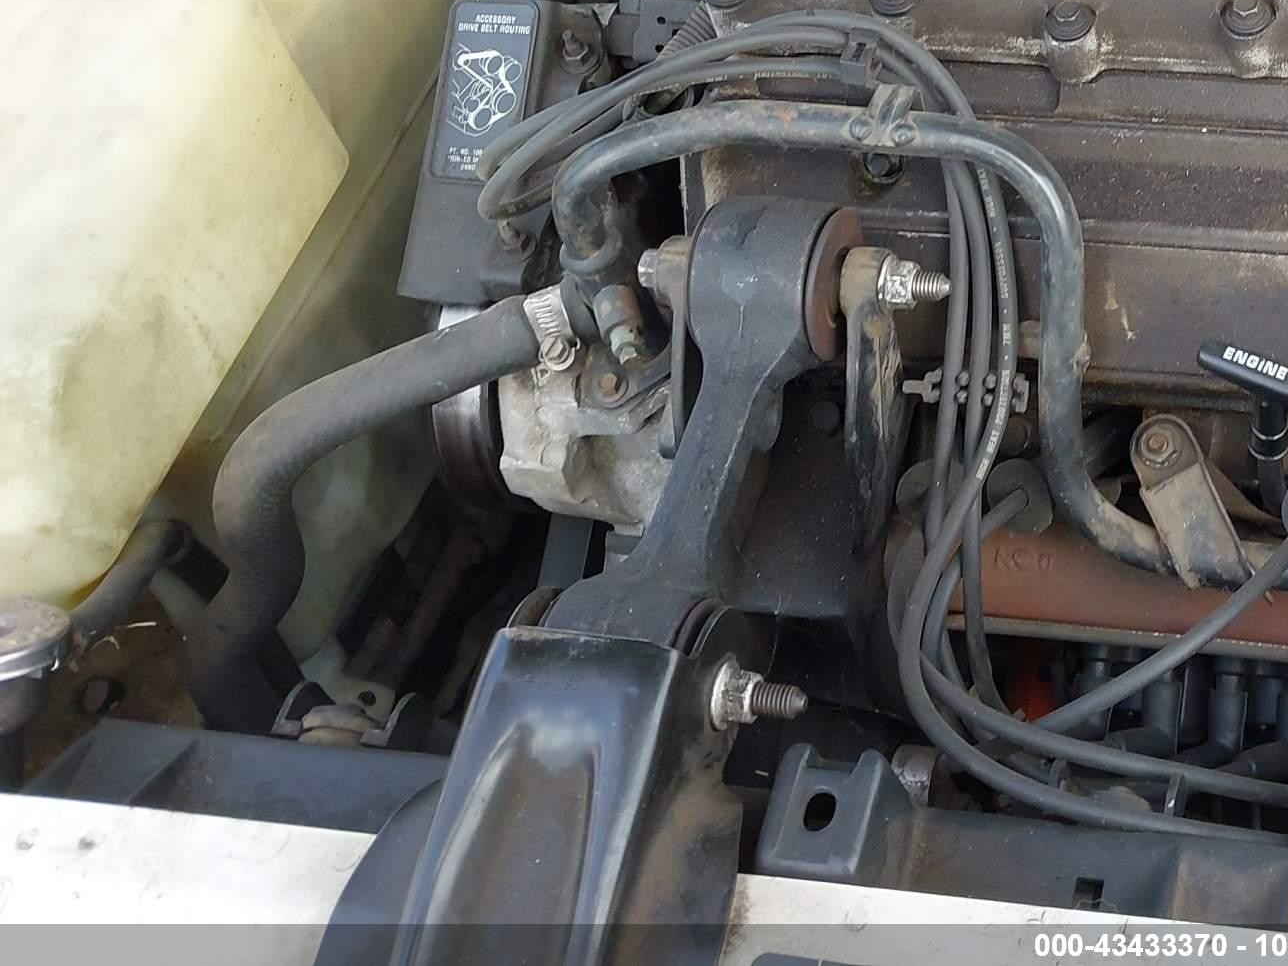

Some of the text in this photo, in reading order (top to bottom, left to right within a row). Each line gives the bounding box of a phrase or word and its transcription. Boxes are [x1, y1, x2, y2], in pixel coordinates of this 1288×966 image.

[475, 13, 517, 24] ACCESSORY
[458, 22, 531, 35] DRIVE BELT ROUTING
[1222, 345, 1288, 381] ENGINE
